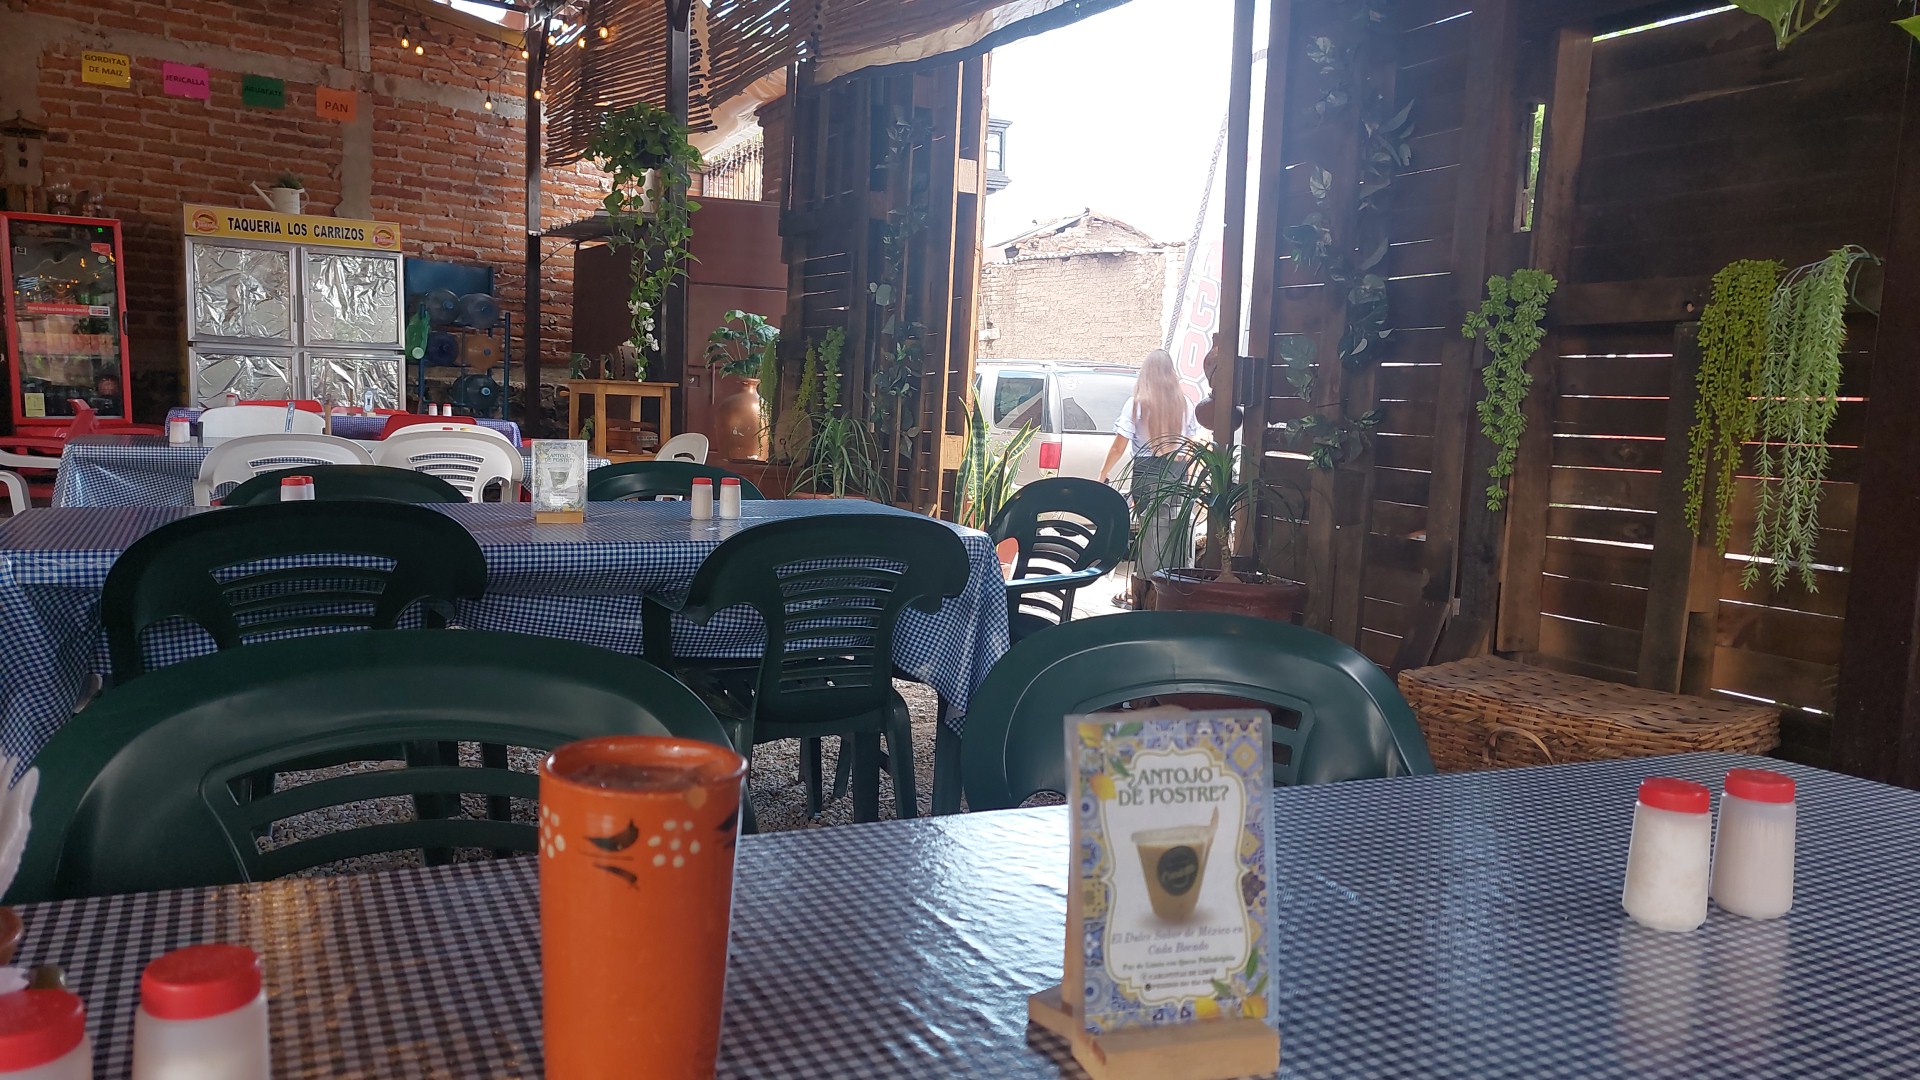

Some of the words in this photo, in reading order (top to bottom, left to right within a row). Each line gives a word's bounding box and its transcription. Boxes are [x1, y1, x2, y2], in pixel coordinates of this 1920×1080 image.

[84, 54, 127, 66] GORDITAS
[89, 65, 100, 73] DE
[102, 67, 124, 77] MAIZ
[165, 74, 206, 87] JERICALLA
[325, 101, 349, 113] PAN
[227, 217, 282, 235] TAQUERÍA
[287, 222, 308, 237] LOS
[313, 224, 365, 242] CARRIZOS
[1127, 766, 1213, 790] ¿ANTOJO
[1118, 786, 1144, 806] DE
[1149, 785, 1229, 805] POSTRE?
